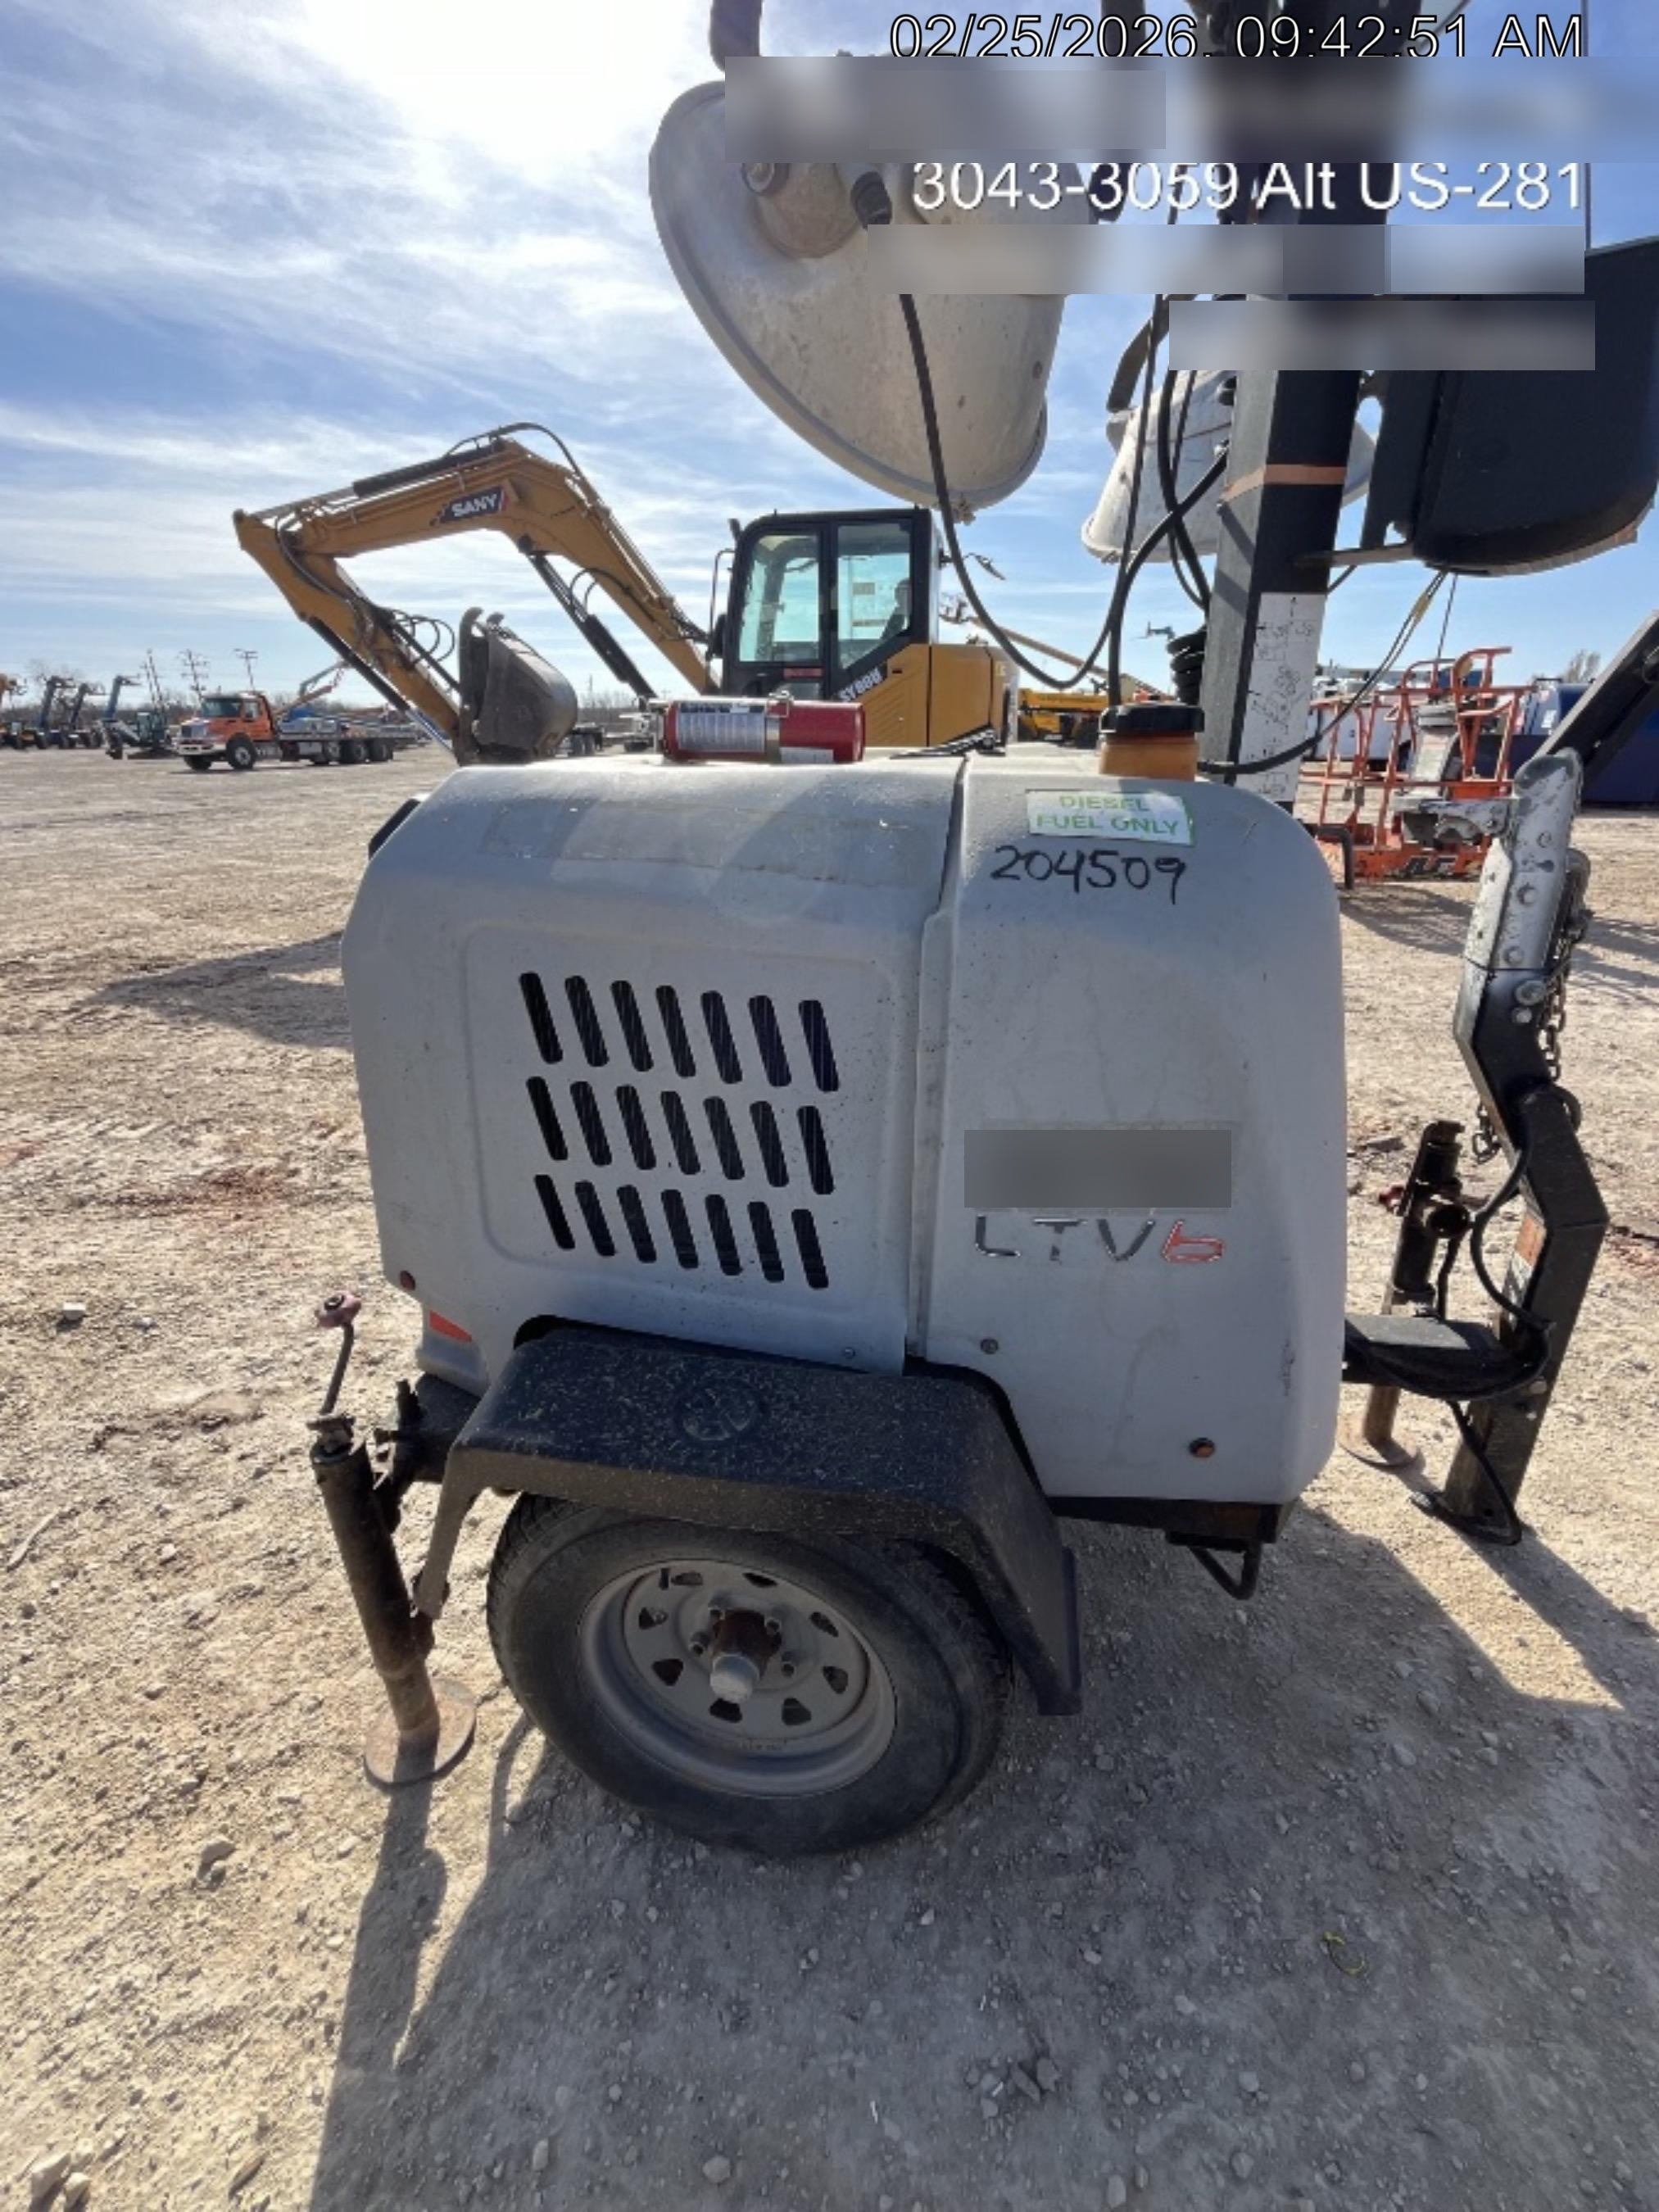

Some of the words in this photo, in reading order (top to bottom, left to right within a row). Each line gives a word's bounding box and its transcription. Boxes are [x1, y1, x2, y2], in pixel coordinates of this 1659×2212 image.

[451, 493, 497, 518] SANY
[1059, 796, 1151, 811] DIESEL
[1036, 815, 1103, 829] FUEL
[1111, 818, 1180, 836] ONLY
[990, 845, 1186, 904] 204509
[975, 1215, 1224, 1263] LTV6
